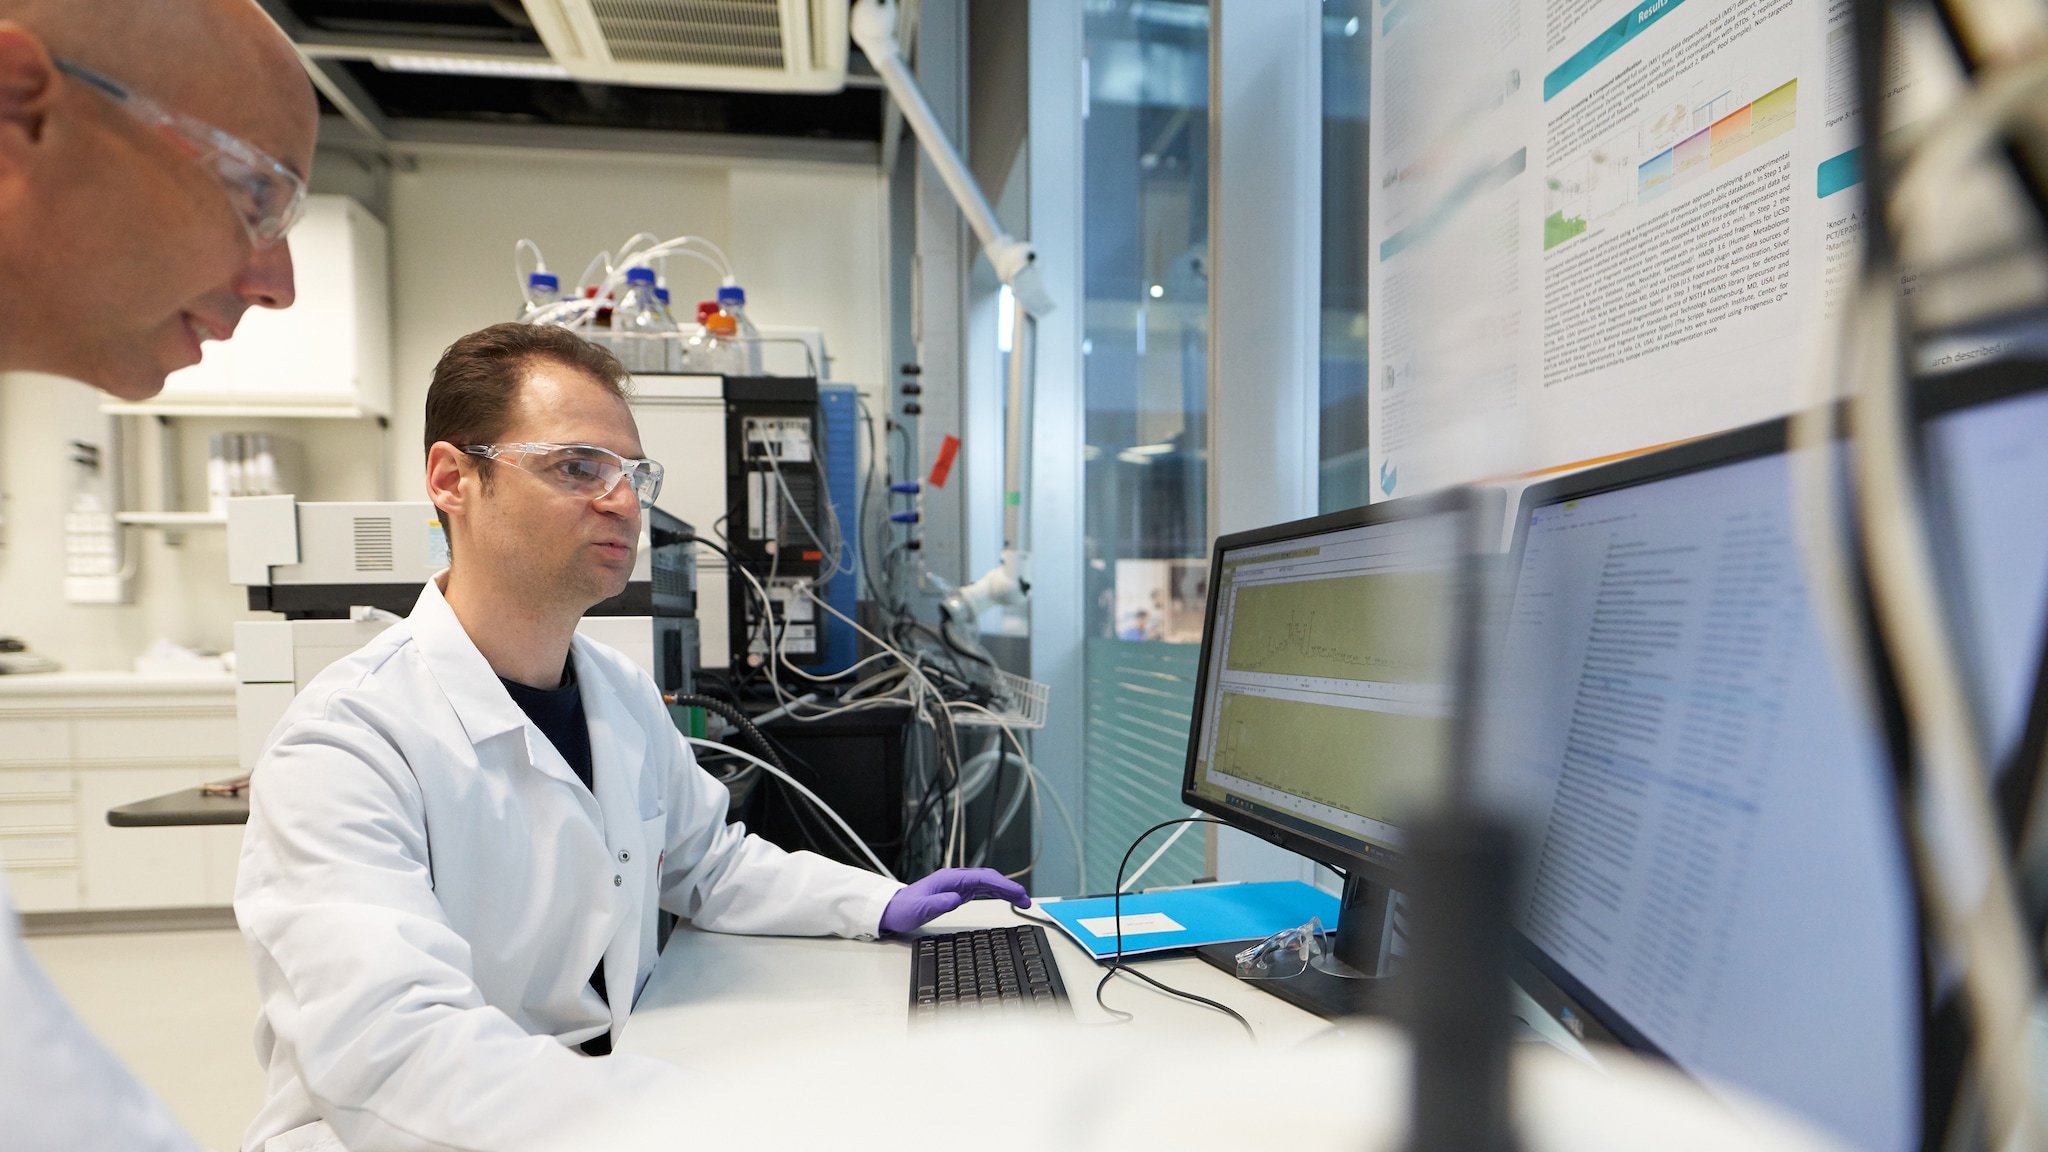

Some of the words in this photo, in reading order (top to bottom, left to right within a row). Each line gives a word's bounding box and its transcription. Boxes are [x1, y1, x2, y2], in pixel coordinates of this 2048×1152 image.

[1638, 0, 1668, 23] Results
[1754, 0, 1793, 27] Non-targeted
[1752, 150, 1789, 174] experimental
[1764, 169, 1776, 179] Step
[1730, 183, 1766, 205] experimental
[1767, 178, 1780, 188] data
[1781, 174, 1789, 182] for
[1738, 190, 1777, 211] fragmentation
[1778, 183, 1790, 194] and
[1757, 204, 1770, 214] Step
[1779, 195, 1789, 204] the
[1734, 218, 1761, 234] fragments
[1773, 205, 1789, 217] UCSD
[1728, 234, 1750, 247] (Human
[1753, 217, 1789, 236] Metabolome
[1731, 245, 1743, 255] with
[1745, 241, 1757, 250] data
[1759, 231, 1781, 244] sources
[1783, 226, 1789, 235] of
[1773, 239, 1788, 249] Silver
[1727, 277, 1744, 287] library
[1746, 265, 1775, 281] (precursor
[1777, 259, 1788, 269] and
[1730, 265, 1749, 276] spectra
[1763, 248, 1789, 263] detected
[1760, 274, 1775, 285] USA)
[1777, 270, 1789, 280] and
[1757, 286, 1776, 297] Center
[1727, 308, 1741, 317] using
[1743, 297, 1773, 312] Progenesis
[1954, 342, 2000, 362] described
